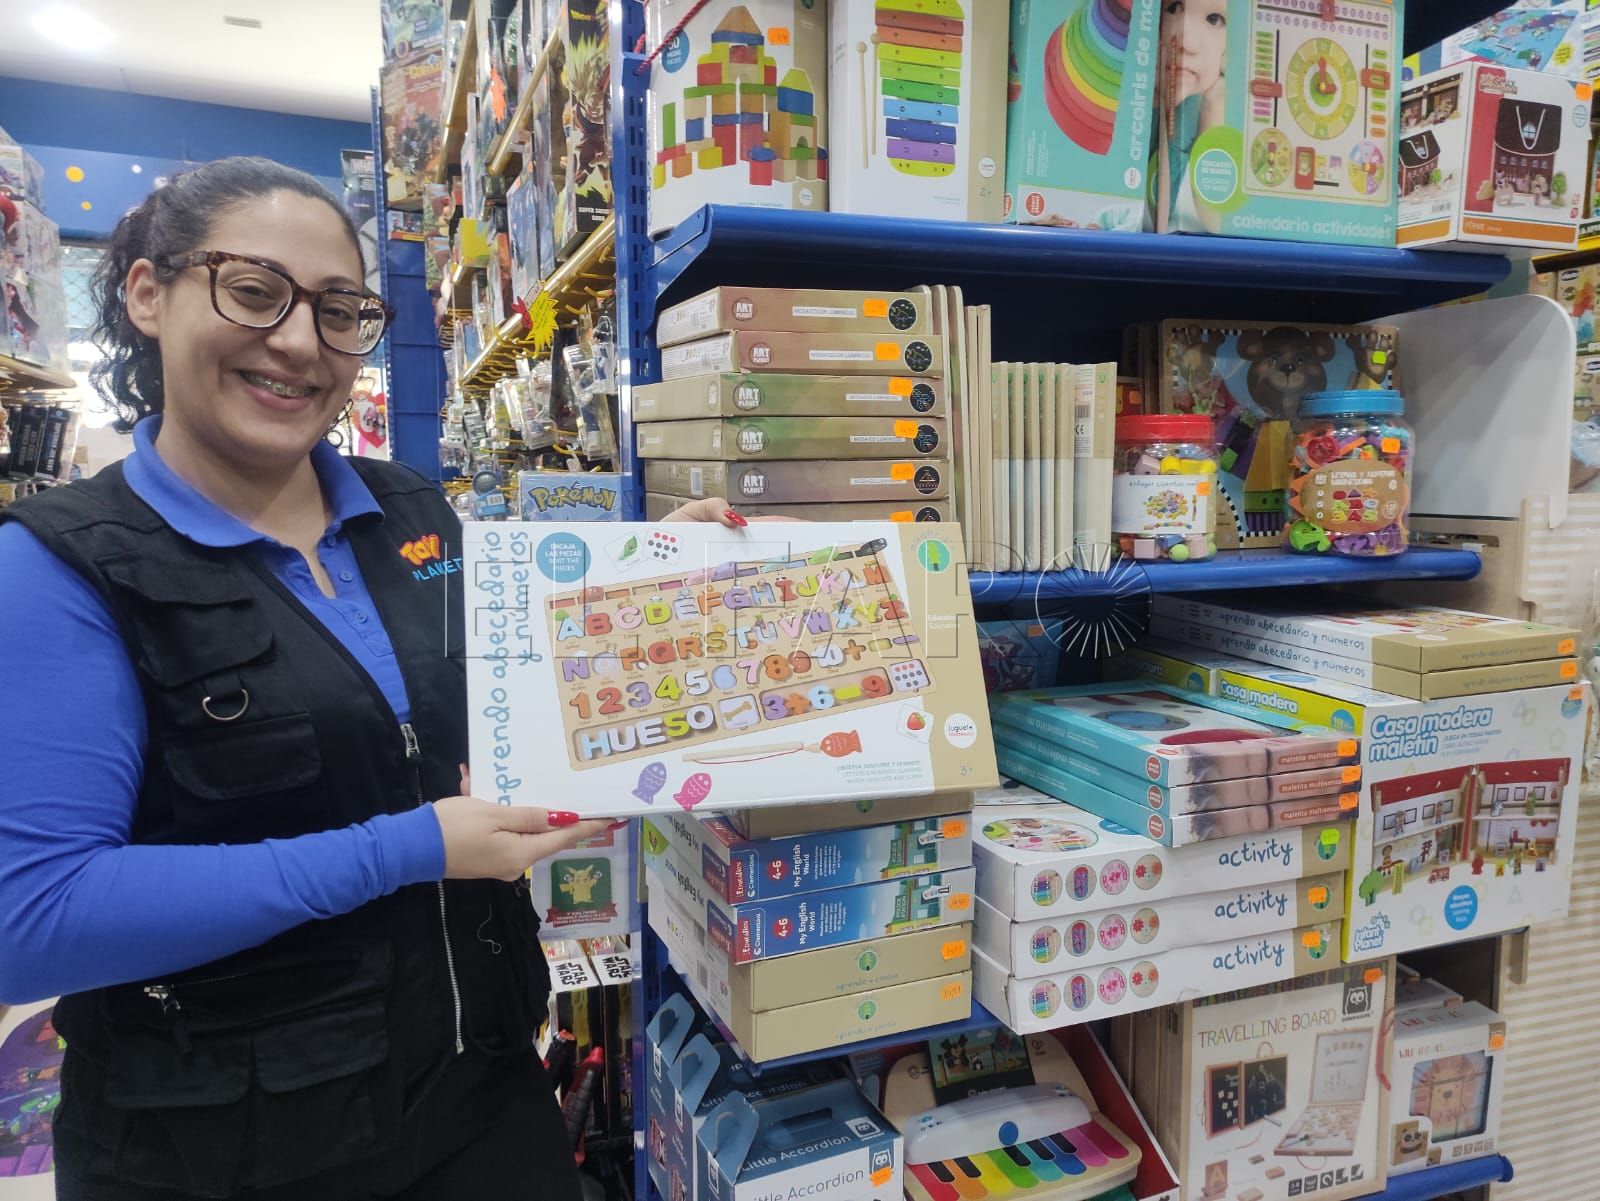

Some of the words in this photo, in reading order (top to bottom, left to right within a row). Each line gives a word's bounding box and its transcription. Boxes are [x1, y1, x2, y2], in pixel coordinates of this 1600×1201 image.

[1135, 37, 1149, 67] de
[1130, 72, 1148, 161] arcoiris
[1232, 214, 1310, 233] calendario
[1313, 221, 1392, 240] actividades
[736, 303, 753, 313] ART
[753, 347, 770, 358] ART
[738, 387, 759, 400] ART
[738, 400, 759, 408] PLANET
[742, 432, 763, 444] ART
[742, 443, 763, 451] PLANET
[743, 475, 764, 487] ART
[743, 486, 764, 495] PLANET
[399, 534, 441, 566] TOY
[508, 531, 531, 642] números
[479, 531, 510, 679] abecedario
[1220, 612, 1256, 626] aprendo
[1257, 620, 1310, 638] abecedario
[1311, 633, 1318, 645] y
[518, 649, 543, 667] y
[1221, 635, 1256, 650] aprendo
[1258, 644, 1310, 663] abecedario
[1312, 658, 1319, 670] y
[1220, 680, 1248, 701] Casa
[1248, 688, 1299, 715] madera
[580, 705, 715, 759] HUESO
[1370, 714, 1420, 740] Casa
[1419, 703, 1493, 735] madera
[1368, 728, 1440, 763] maletín
[792, 844, 802, 876] English
[1218, 838, 1294, 867] activity
[772, 860, 783, 880] 4-6
[794, 876, 802, 888] My
[1214, 889, 1289, 919] activity
[778, 918, 789, 937] 4-6
[798, 902, 808, 933] English
[808, 911, 816, 932] World
[799, 933, 808, 945] My
[601, 956, 623, 979] WARS
[614, 956, 633, 979] STAR
[1212, 939, 1286, 970] activity
[555, 963, 577, 986] WARS
[567, 962, 589, 985] STAR
[1197, 1016, 1289, 1049] TRAVELLING
[1291, 1008, 1338, 1032] BOARD
[780, 1135, 852, 1161] Accordion
[787, 1169, 864, 1201] Accordion
